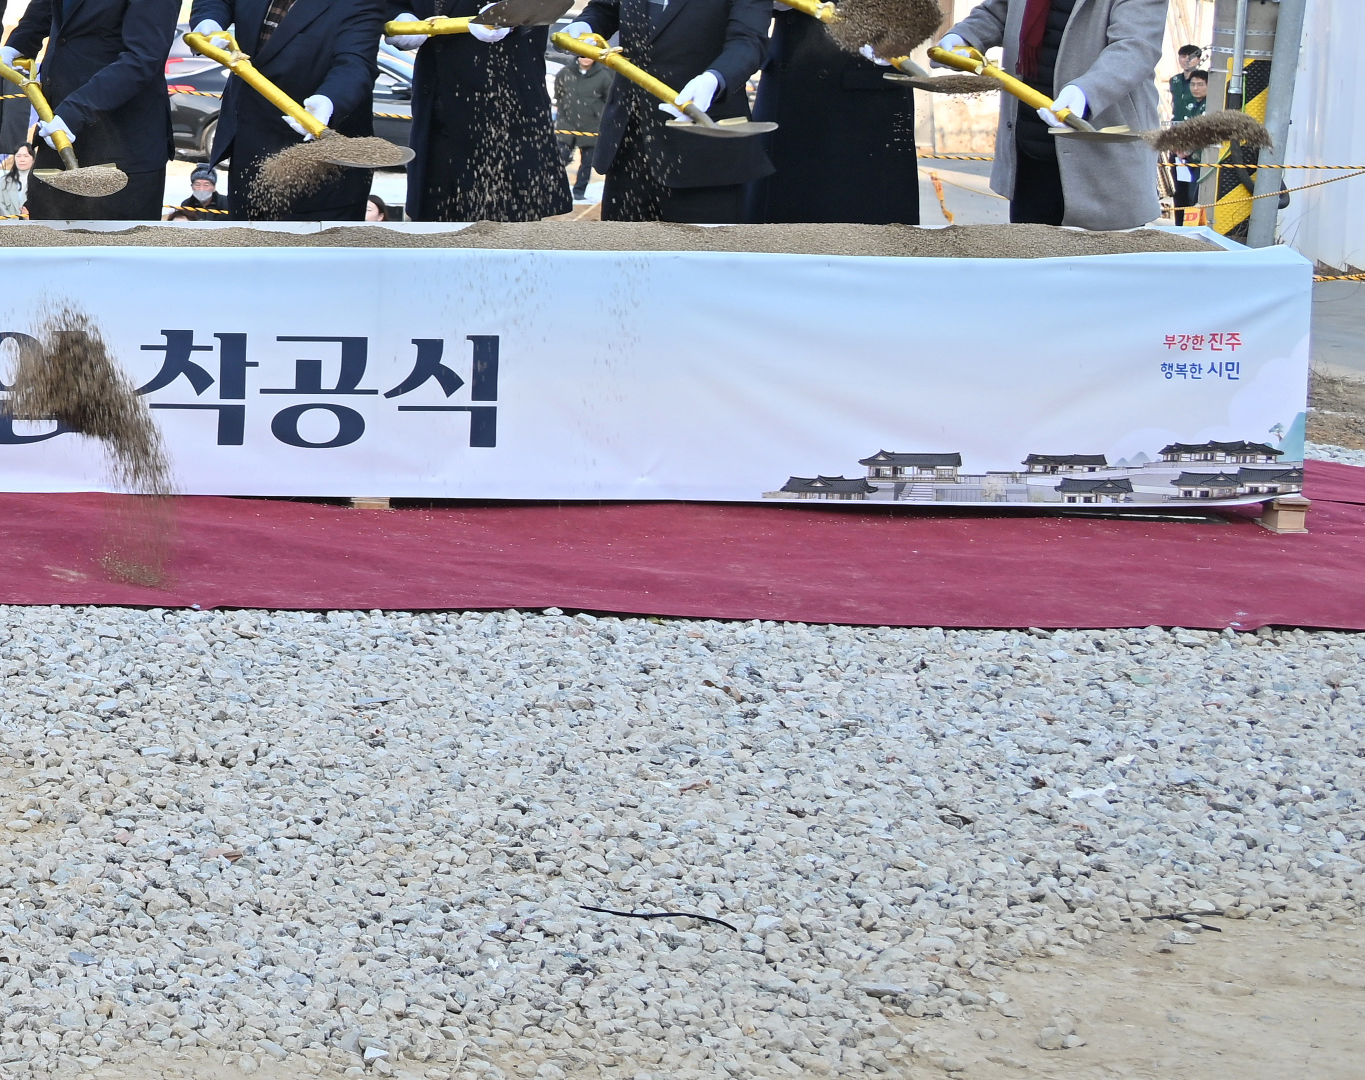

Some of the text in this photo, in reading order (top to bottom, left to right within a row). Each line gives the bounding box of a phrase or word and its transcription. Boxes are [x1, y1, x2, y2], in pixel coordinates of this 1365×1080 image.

[1162, 332, 1243, 352] 부강한 진주
[1160, 361, 1241, 381] 행복한 시민
[133, 329, 501, 449] 착공식
